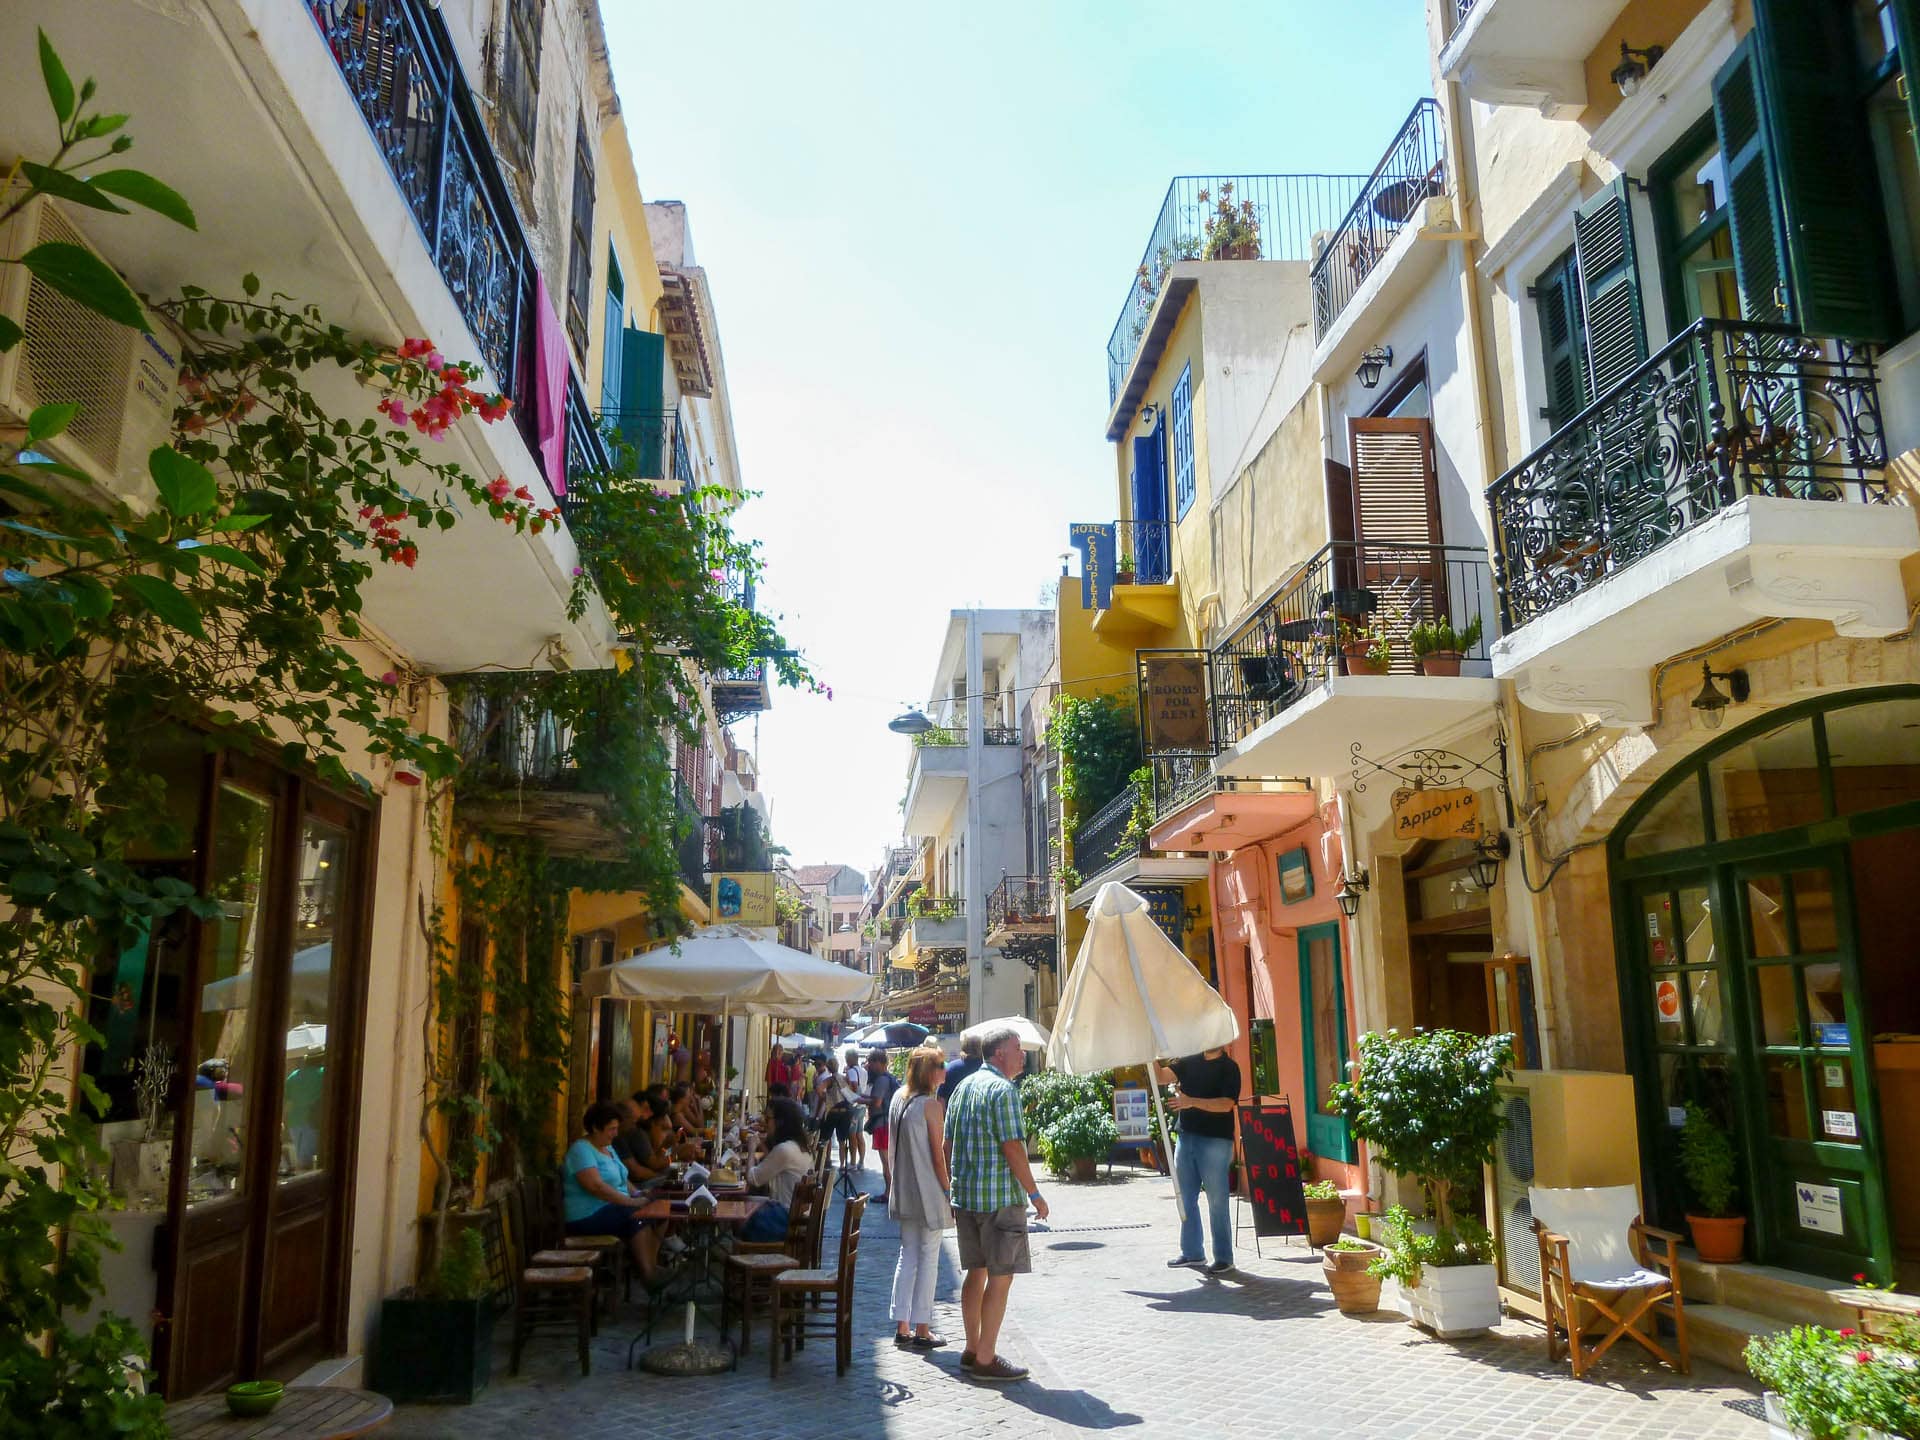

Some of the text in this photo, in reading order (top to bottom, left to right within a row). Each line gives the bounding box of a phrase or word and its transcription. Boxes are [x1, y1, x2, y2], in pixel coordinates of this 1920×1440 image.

[1071, 524, 1108, 537] HOTEL
[1087, 535, 1098, 564] CASA
[1154, 684, 1200, 695] ROOMS
[1166, 697, 1190, 707] FOR
[1161, 709, 1197, 720] RENT
[743, 887, 771, 906] Bakery
[1152, 901, 1168, 911] SA
[938, 1012, 965, 1021] MARKET
[1242, 1110, 1297, 1160] ROOMS
[1251, 1162, 1297, 1179] FOR
[1253, 1187, 1305, 1233] RENT
